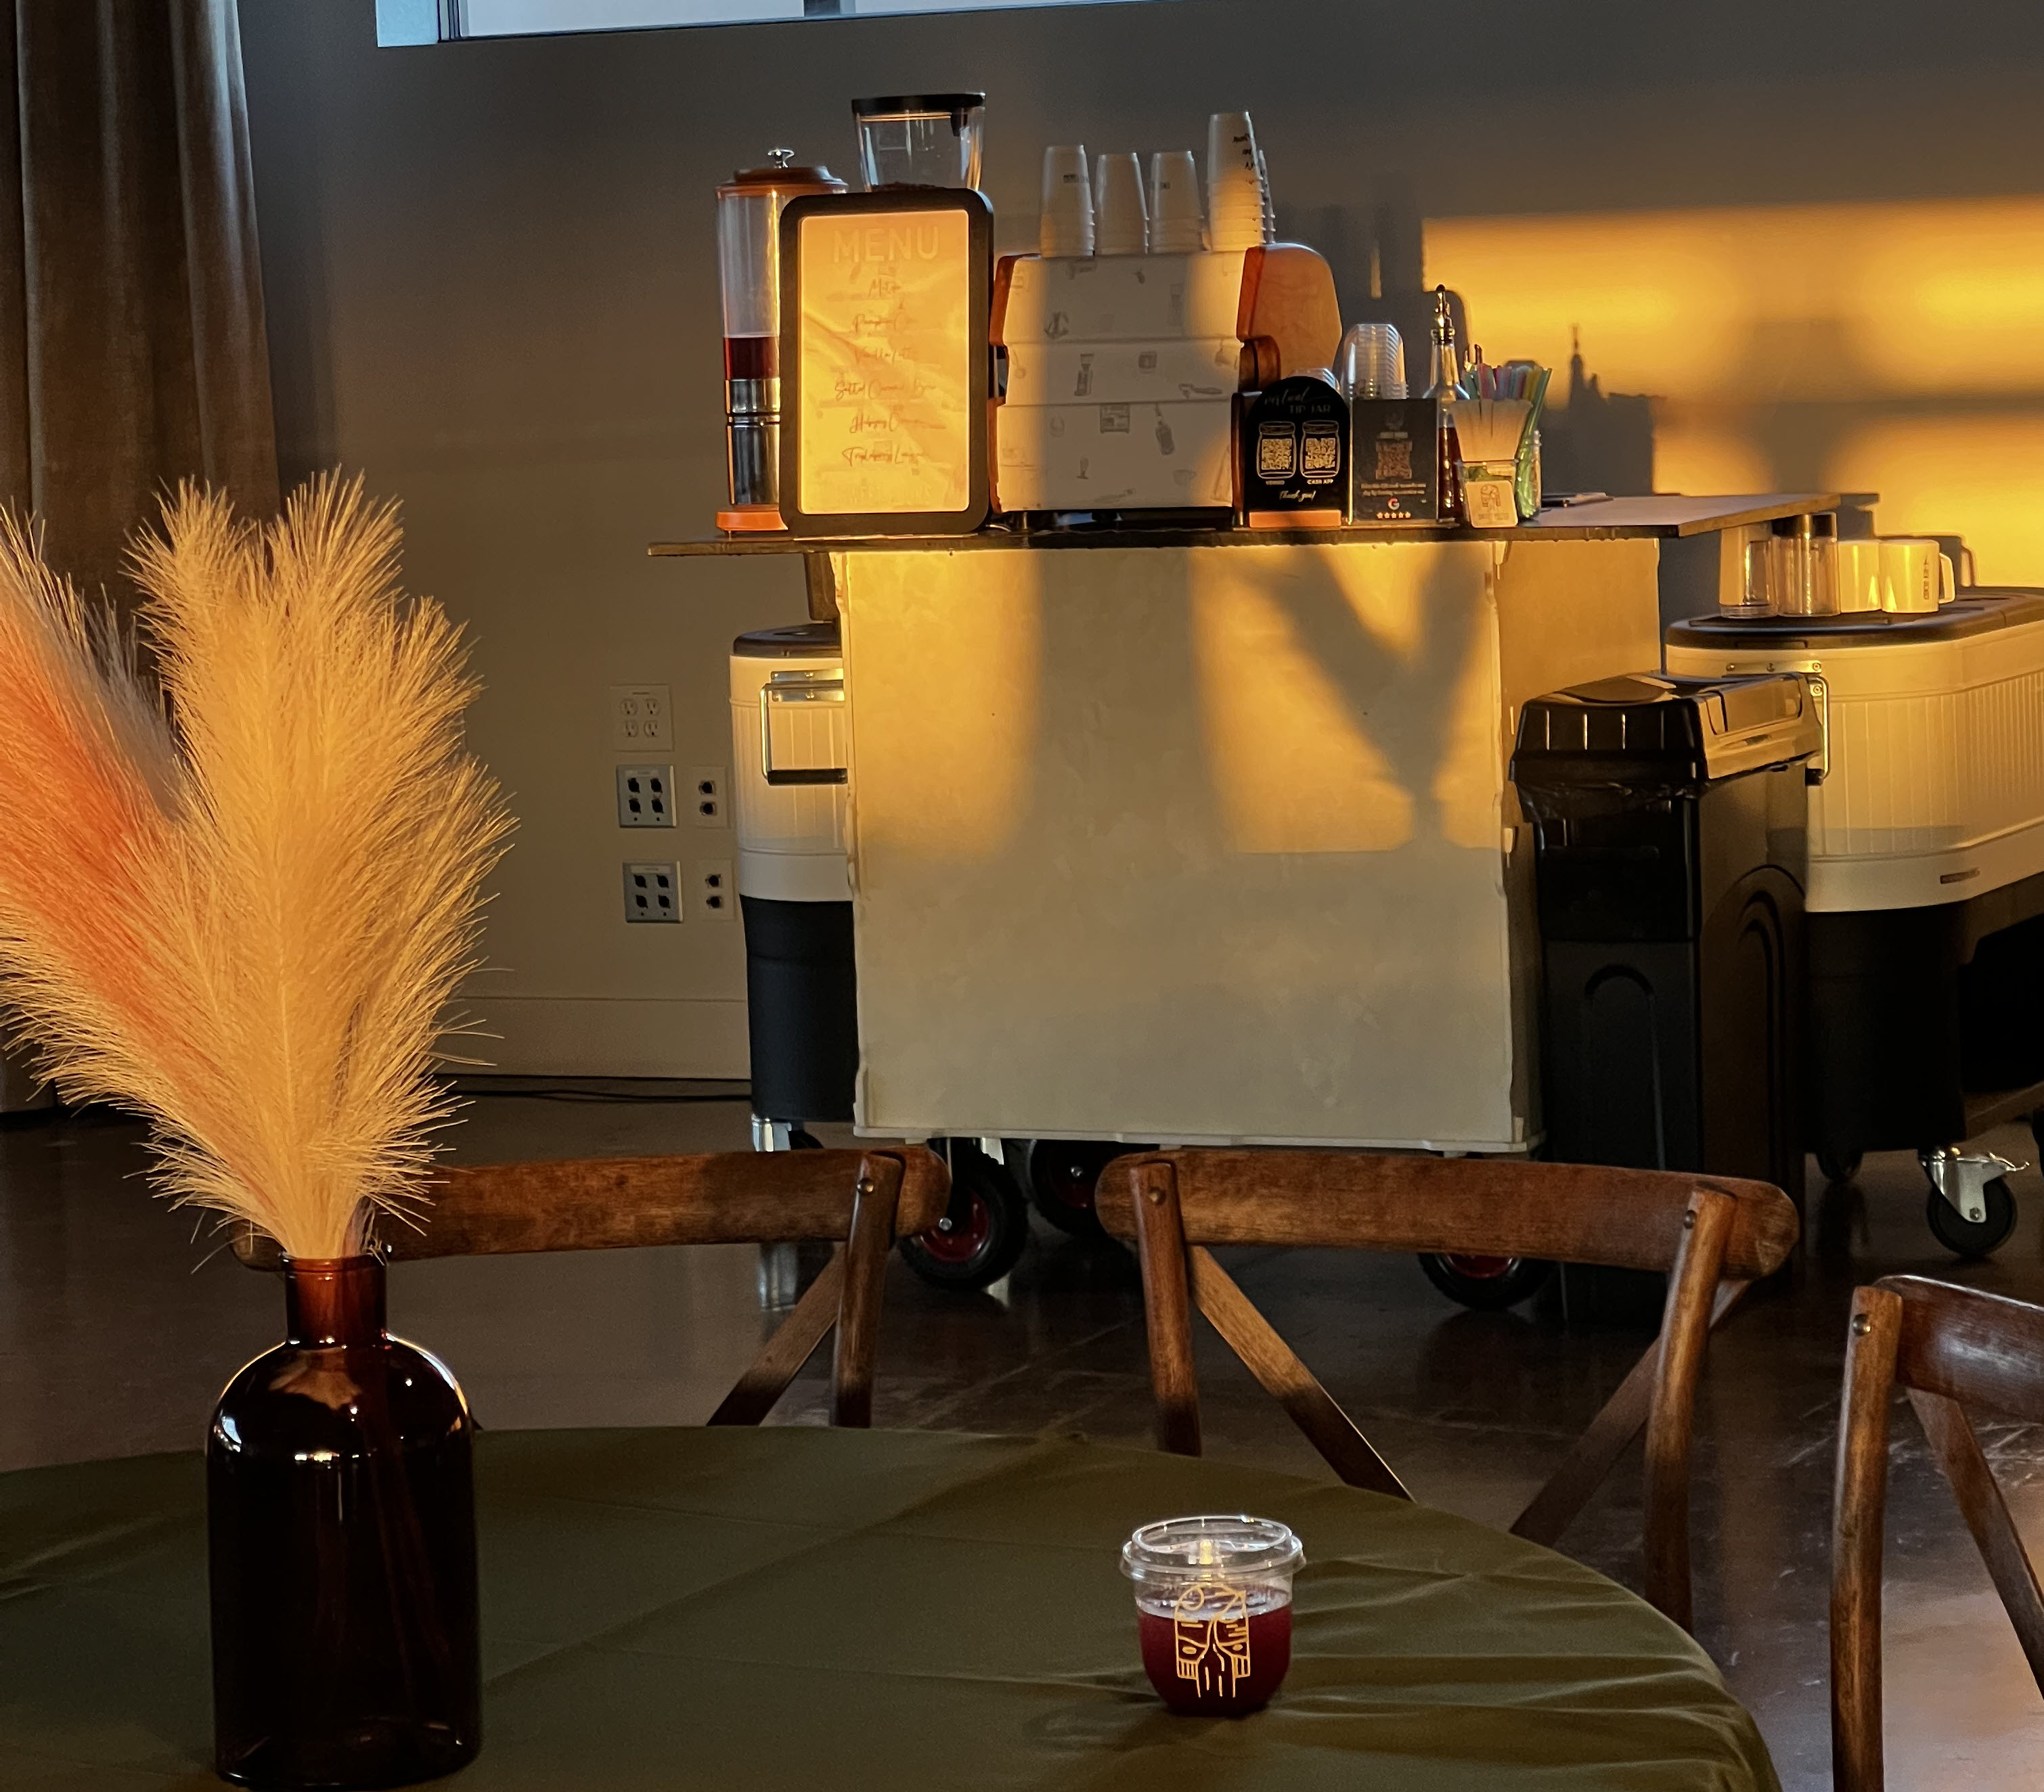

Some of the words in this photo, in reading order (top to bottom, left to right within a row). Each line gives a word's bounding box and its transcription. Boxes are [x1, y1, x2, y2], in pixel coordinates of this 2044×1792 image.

[833, 226, 939, 263] MENU
[1289, 405, 1306, 413] TIP
[1387, 498, 1400, 510] G
